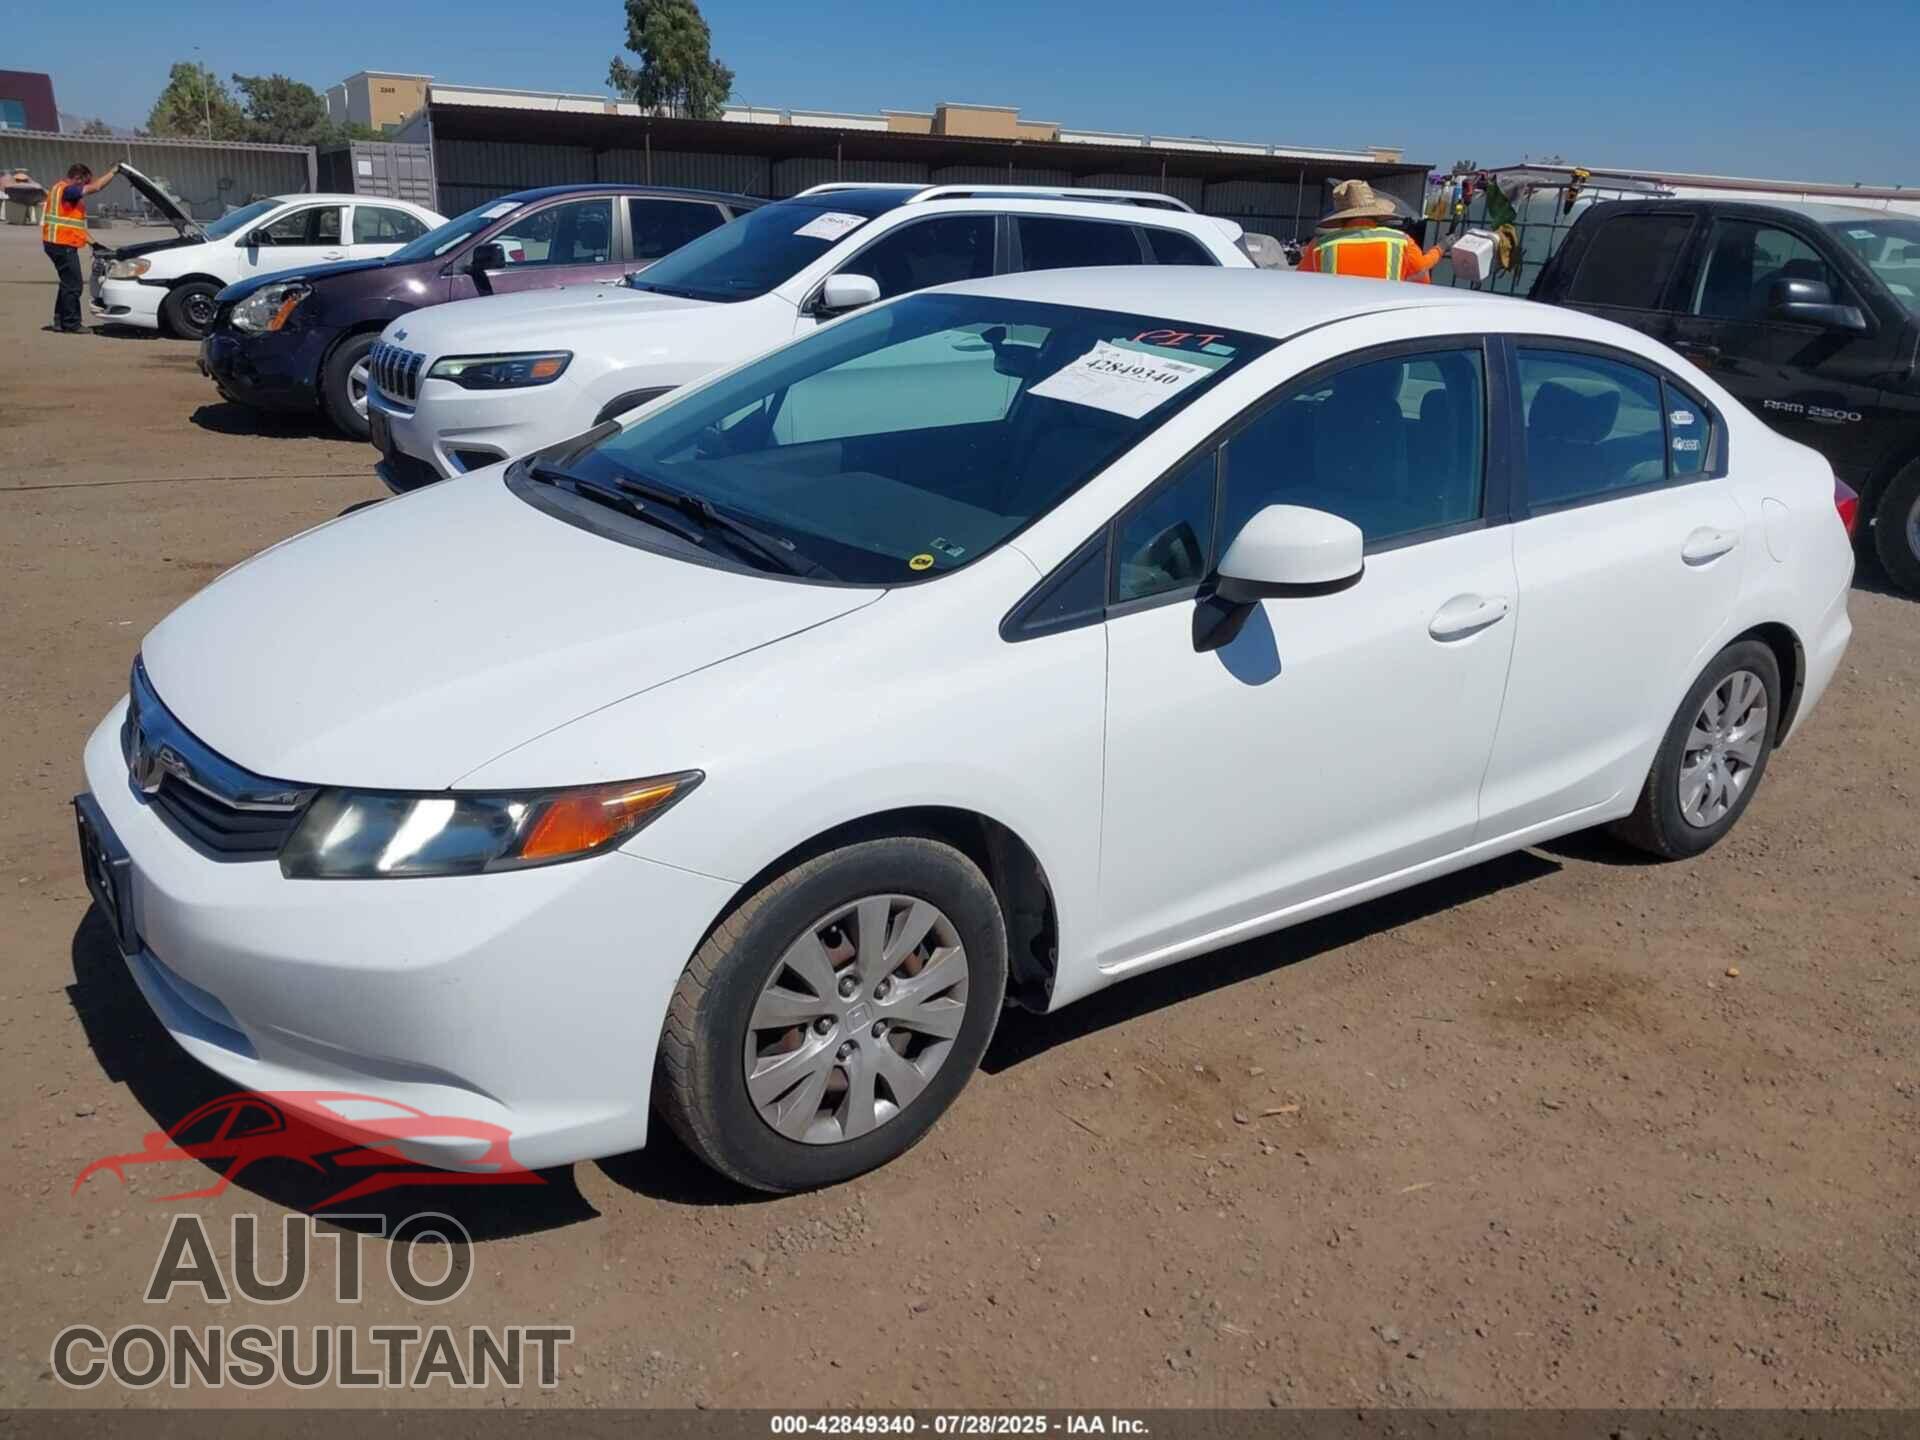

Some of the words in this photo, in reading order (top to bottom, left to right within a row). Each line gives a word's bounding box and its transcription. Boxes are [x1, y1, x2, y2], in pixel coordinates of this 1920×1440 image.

[1086, 359, 1180, 385] 42849340
[1763, 399, 1804, 413] RAM
[1807, 405, 1862, 421] 2500
